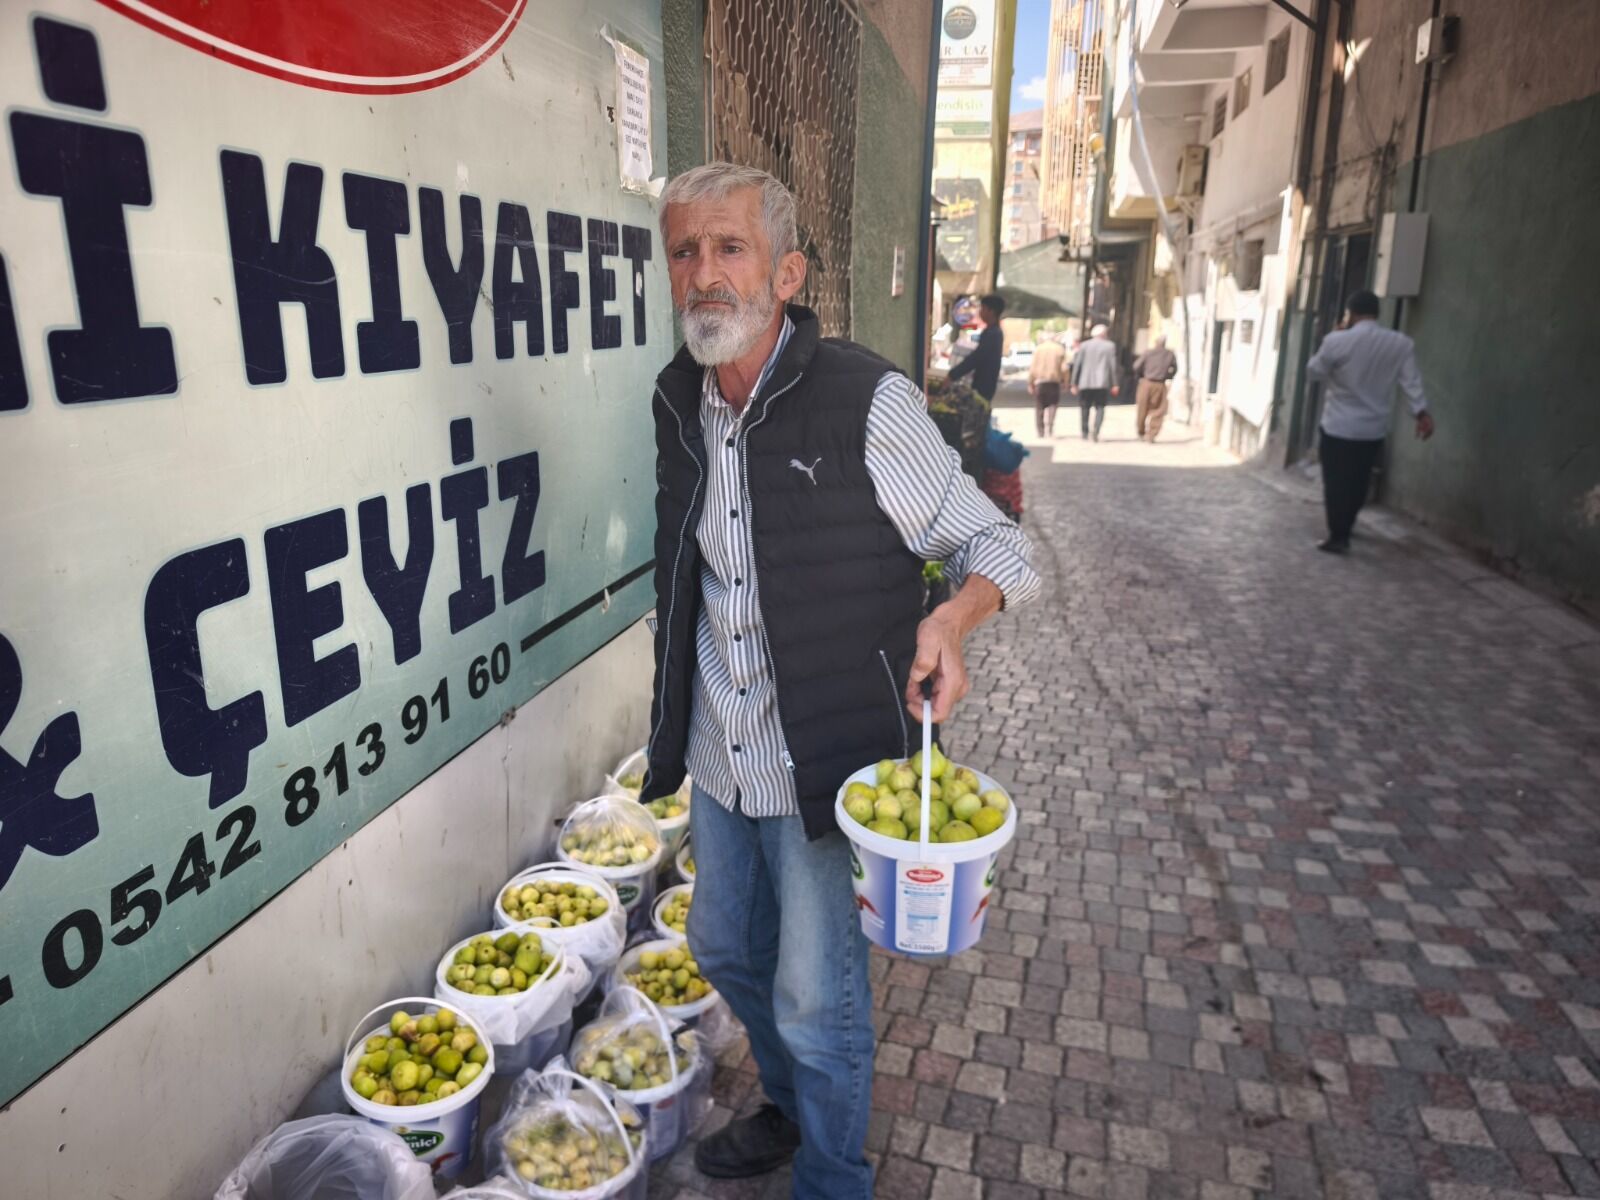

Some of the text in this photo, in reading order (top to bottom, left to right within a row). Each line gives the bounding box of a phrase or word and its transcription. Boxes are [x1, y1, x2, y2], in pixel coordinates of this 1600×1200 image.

[0, 16, 652, 412] İ KIYAFET
[144, 417, 547, 810] ÇEYİZ
[42, 641, 512, 990] 0542 813 91 60
